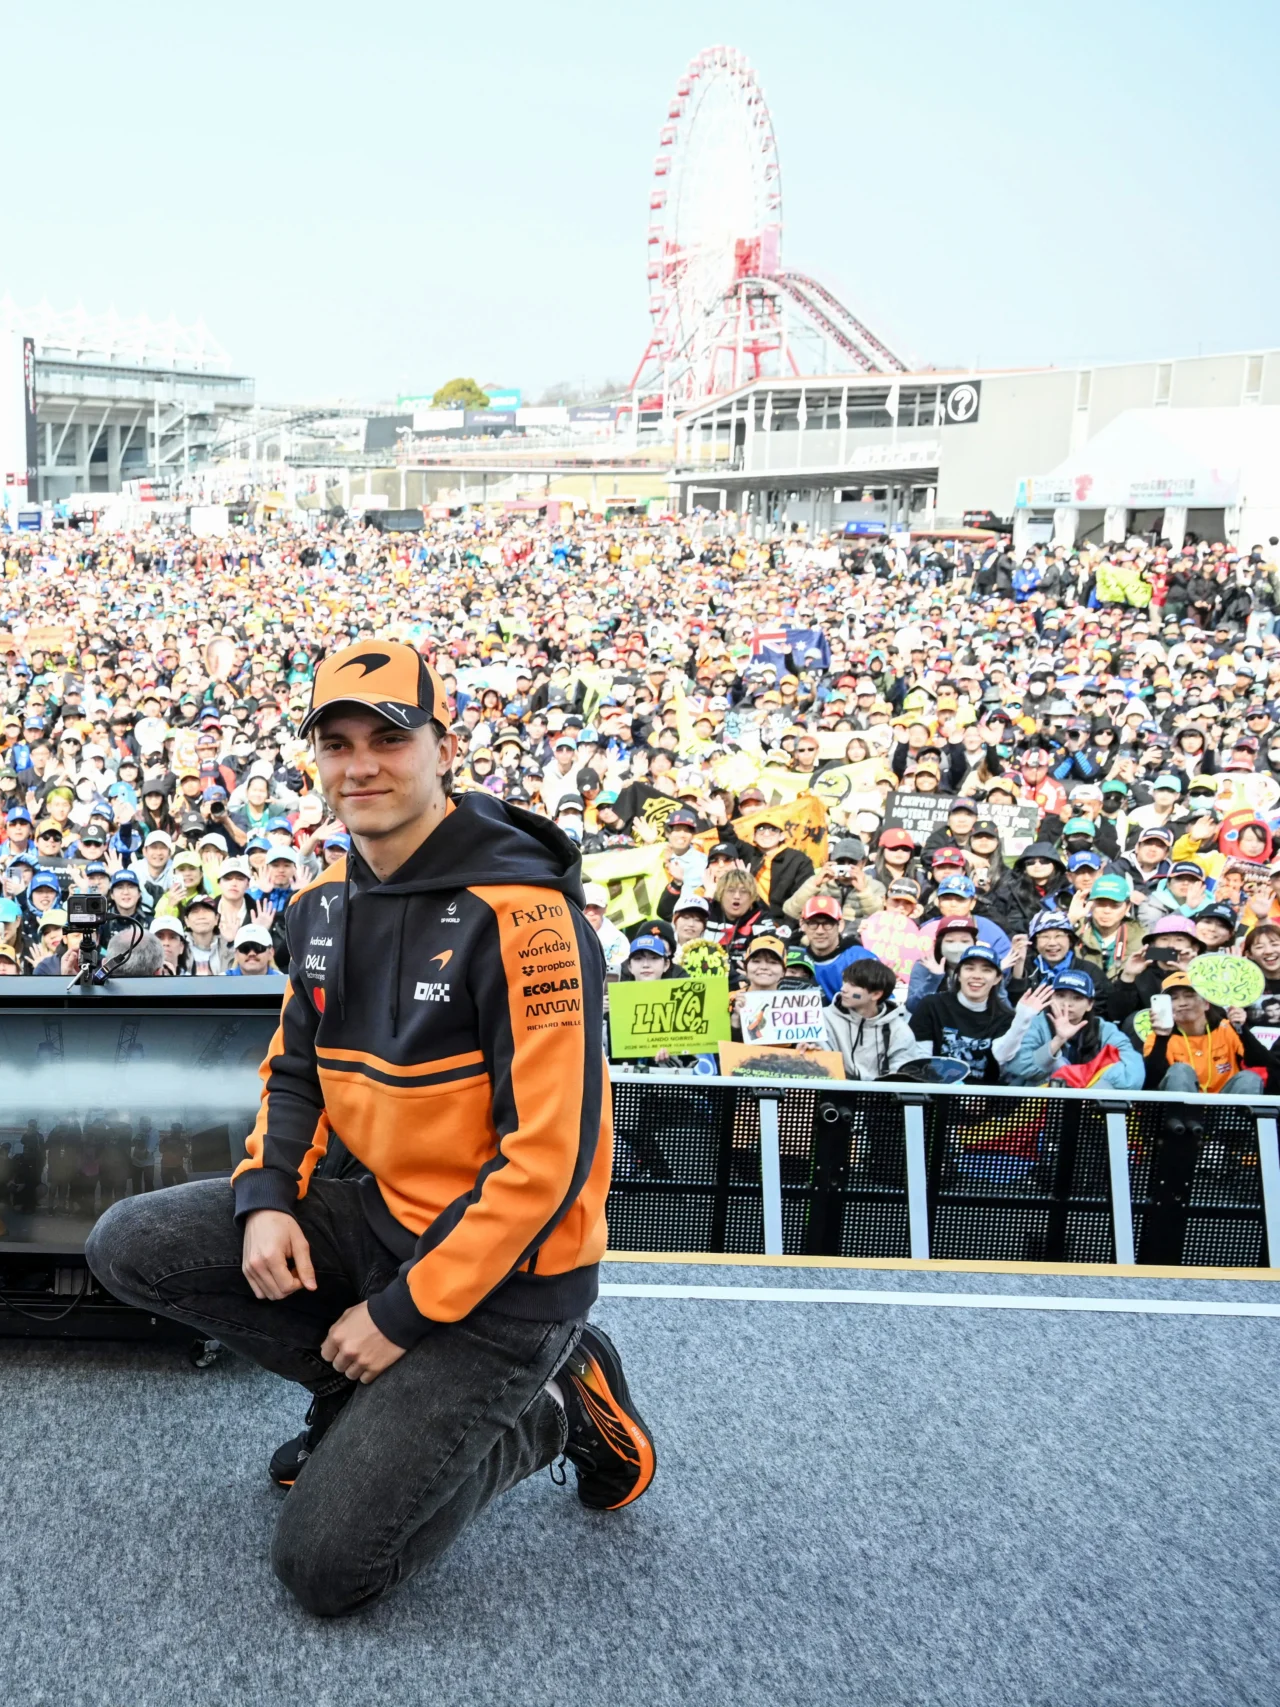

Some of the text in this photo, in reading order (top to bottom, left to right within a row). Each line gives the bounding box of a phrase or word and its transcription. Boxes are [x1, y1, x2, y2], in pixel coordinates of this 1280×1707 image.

[932, 809, 949, 822] EXA
[510, 903, 564, 928] FxPro
[517, 940, 572, 959] workday
[305, 953, 327, 971] DELL
[536, 959, 577, 974] Dropbox
[413, 981, 451, 1003] OKX
[522, 977, 580, 998] ECOLAB
[525, 998, 581, 1018] ARROW
[771, 995, 821, 1009] LANDO
[526, 1019, 582, 1032] RICHARD MILLE
[771, 1010, 821, 1028] POLE!
[775, 1026, 823, 1042] TODAY
